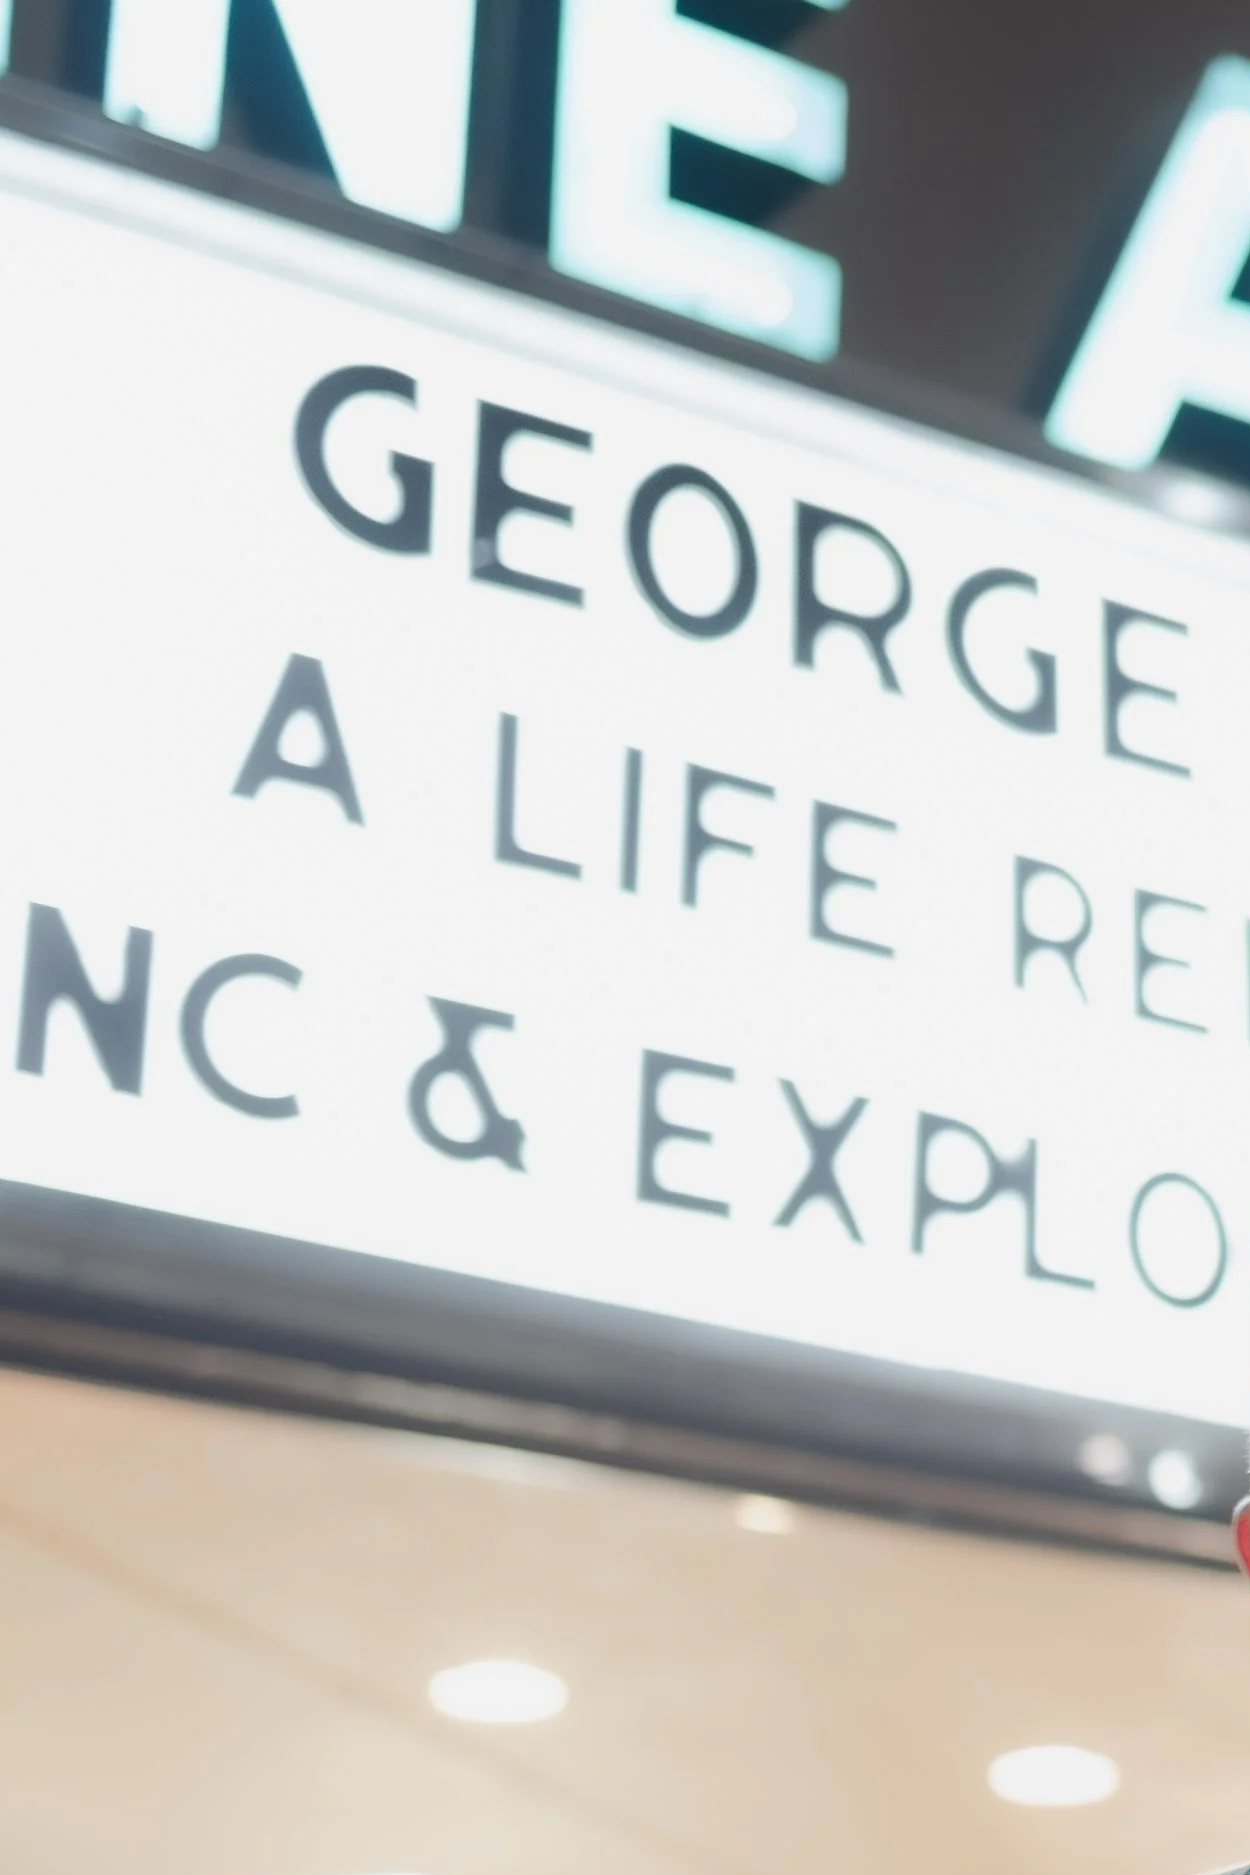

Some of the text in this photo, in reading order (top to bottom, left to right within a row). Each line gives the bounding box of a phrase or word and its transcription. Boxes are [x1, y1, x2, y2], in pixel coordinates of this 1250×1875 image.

[0, 0, 848, 363] NE
[292, 362, 1193, 780] GEORGE
[230, 651, 366, 828] A
[493, 710, 900, 960] LIFE
[13, 900, 306, 1122] NC
[405, 994, 529, 1175] &
